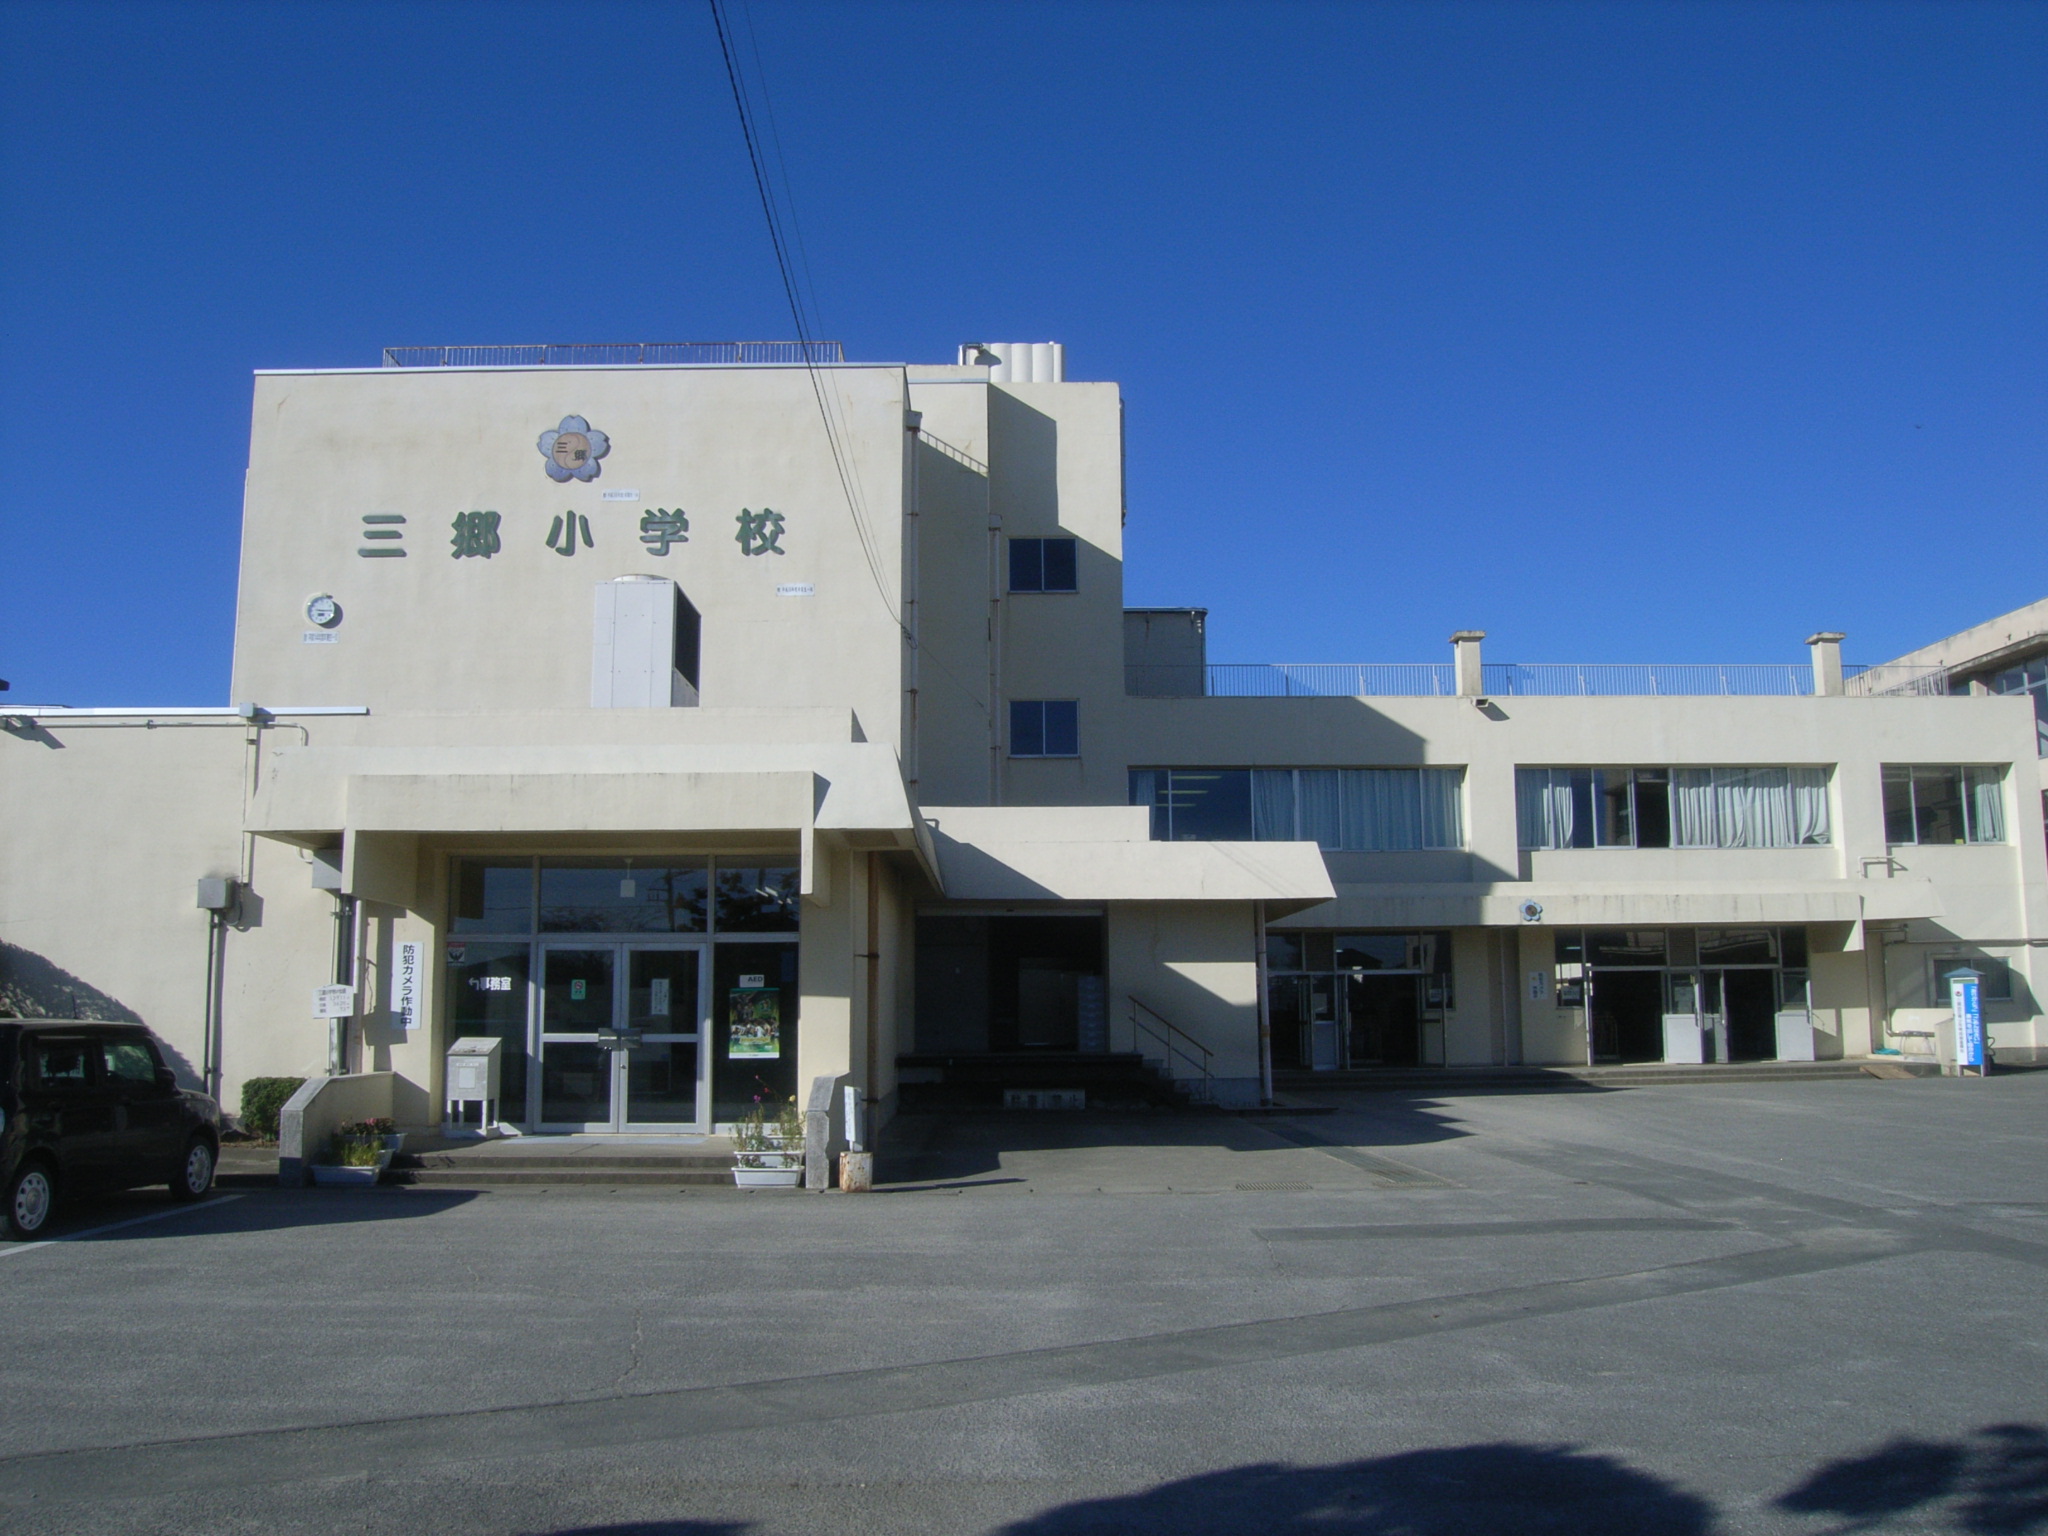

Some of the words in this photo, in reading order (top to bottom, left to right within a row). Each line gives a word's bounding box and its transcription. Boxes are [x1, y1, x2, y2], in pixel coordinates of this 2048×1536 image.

[358, 508, 786, 558] 三郷小学校
[401, 945, 415, 1027] 防犯カメラ作動中
[480, 976, 512, 991] 事務室
